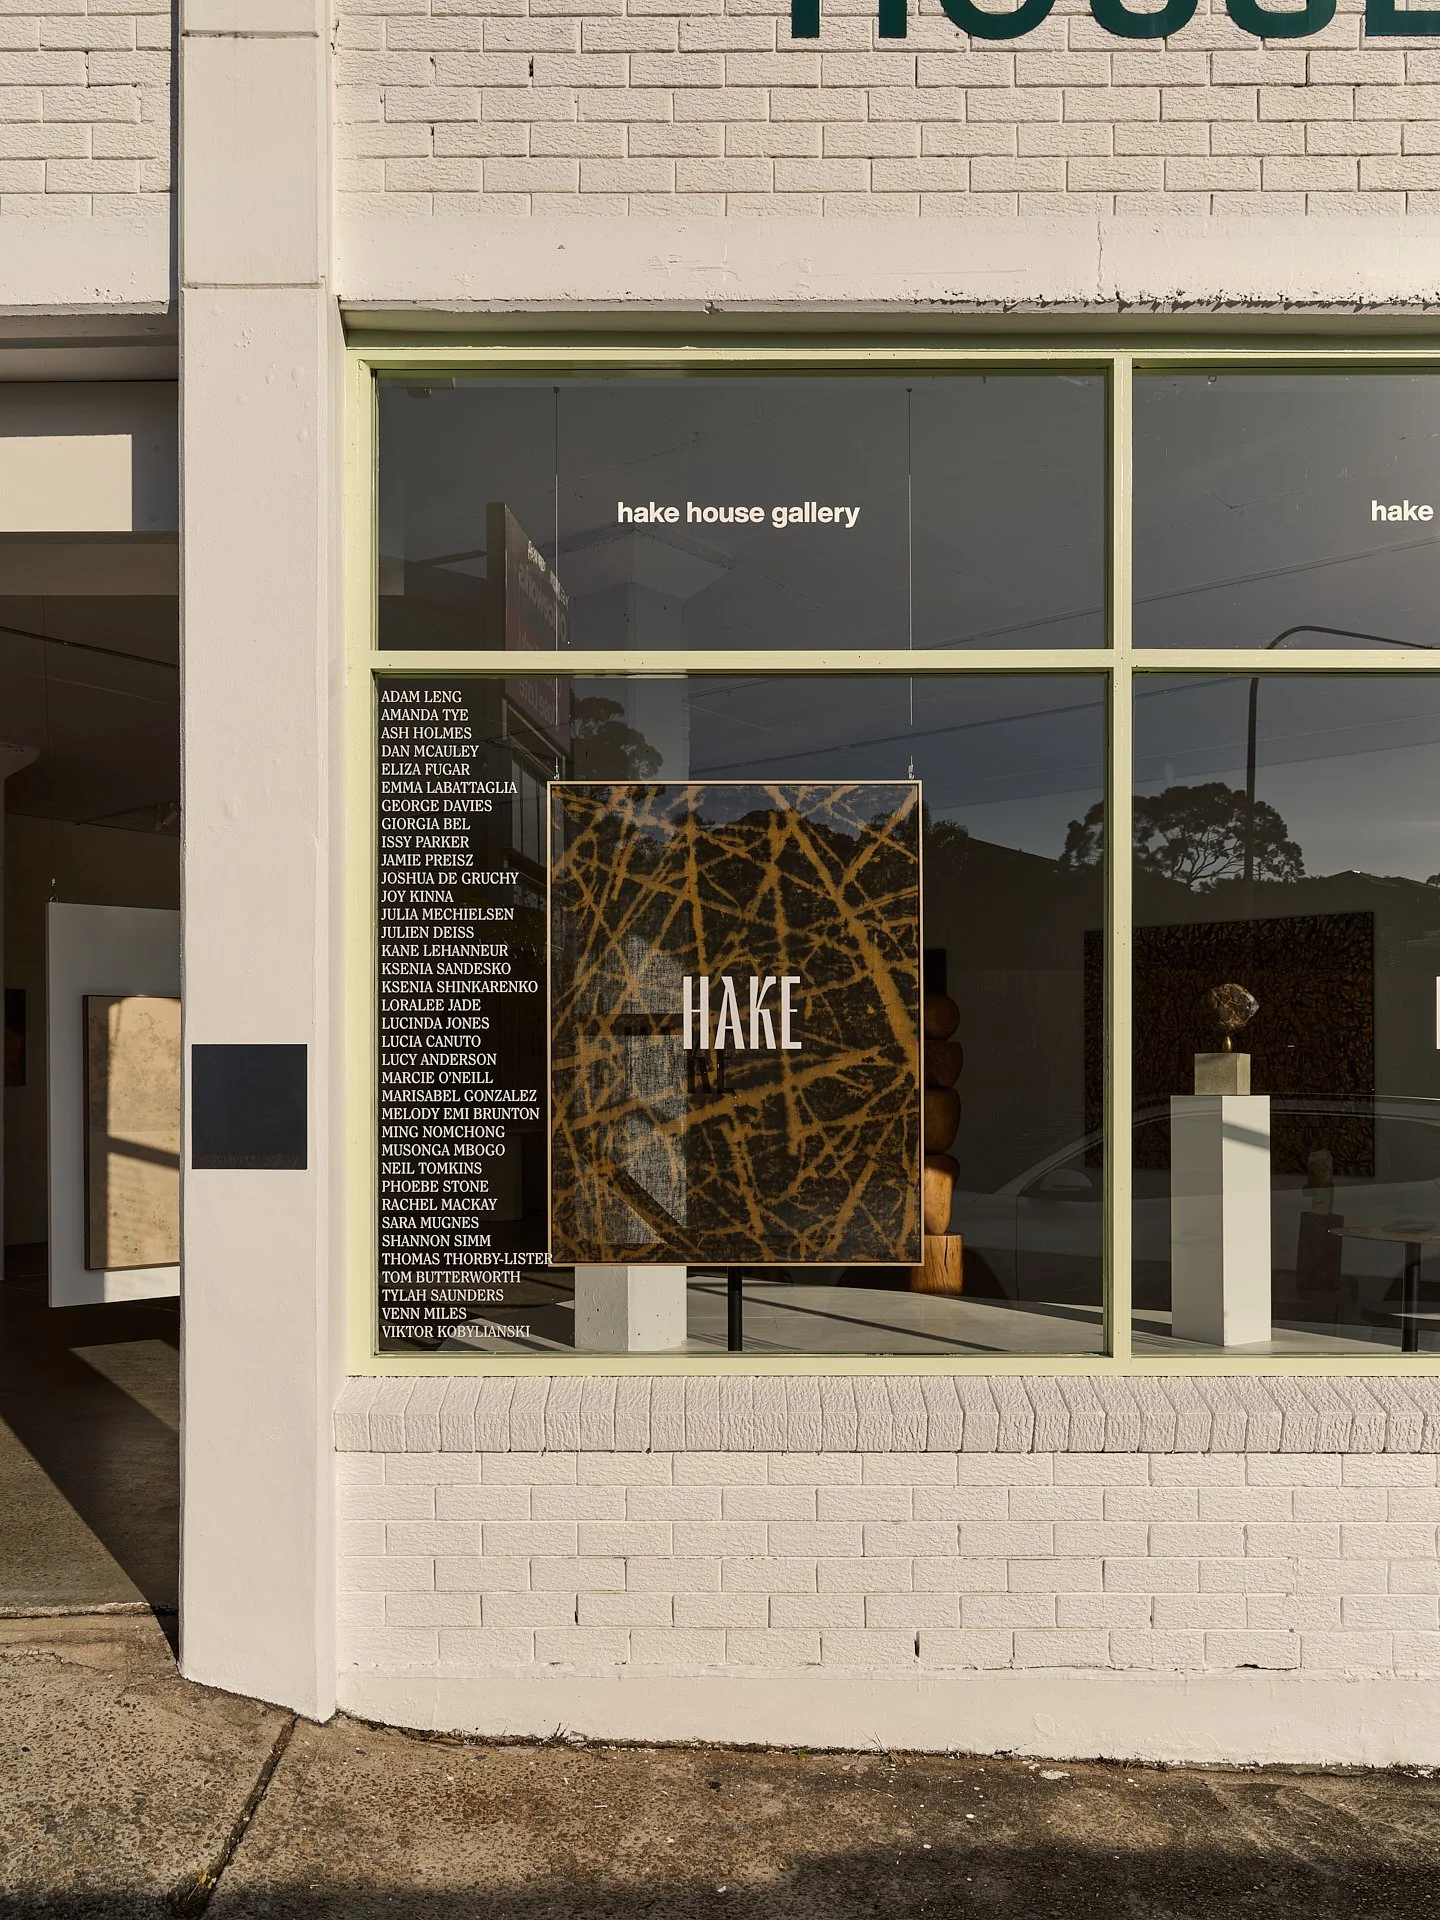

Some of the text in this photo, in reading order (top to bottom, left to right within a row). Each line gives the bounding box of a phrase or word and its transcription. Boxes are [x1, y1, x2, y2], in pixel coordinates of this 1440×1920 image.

[617, 501, 860, 528] hake house gallery
[1371, 499, 1434, 521] hake
[380, 690, 462, 703] ADAM LENG
[380, 708, 469, 721] AMANDA TYE
[380, 726, 472, 740] ASH HOLMES
[381, 744, 480, 758] DAN MCAULEY
[381, 762, 471, 776] ELIZA FUGAR
[381, 781, 519, 794] EMMA LABATTAGLIA
[381, 799, 493, 812] GEORGE DAVIES
[381, 817, 471, 830] GIORGIA BEL
[381, 835, 470, 849] ISSY PARKER
[380, 853, 474, 867] JAMIE PREISZ
[380, 871, 520, 885] JOSHUA DE GRUCHY
[380, 890, 455, 903] JOY KINNA
[380, 907, 514, 921] JULIA MECHIELSEN
[380, 926, 475, 939] JULIEN DEISS
[381, 944, 509, 957] KANE LEHANNEUR
[381, 962, 512, 975] KSENIA SANDESKO
[381, 980, 539, 993] KSENIA SHINKARENKO
[381, 998, 482, 1012] LORALEE JADE
[682, 975, 803, 1051] HAKE
[381, 1016, 490, 1030] LUCINDA JONES
[381, 1035, 482, 1048] LUCIA CANUTO
[381, 1053, 497, 1066] LUCY ANDERSON
[381, 1071, 494, 1084] MARCIE O'NEILL
[381, 1089, 537, 1102] MARISABEL GONZALEZ
[381, 1107, 540, 1120] MELODY EMI BRUNTON
[381, 1125, 506, 1138] MING NOMCHONG
[381, 1143, 506, 1157] MUSONGA MBOGO
[381, 1161, 483, 1175] NEIL TOMKINS
[381, 1180, 489, 1193] PHOEBE STONE
[381, 1198, 498, 1211] RACHEL MACKAY
[381, 1216, 480, 1229] SARA MUGNES
[381, 1234, 492, 1247] SHANNON SIMM
[381, 1252, 555, 1266] THOMAS THORBY-LISTER
[381, 1270, 521, 1284] TOM BUTTERWORTH
[381, 1288, 504, 1302] TYLAH SAUNDERS
[381, 1307, 467, 1320] VENN MILES
[381, 1325, 531, 1338] VIKTOR KOBYLIANSKI
